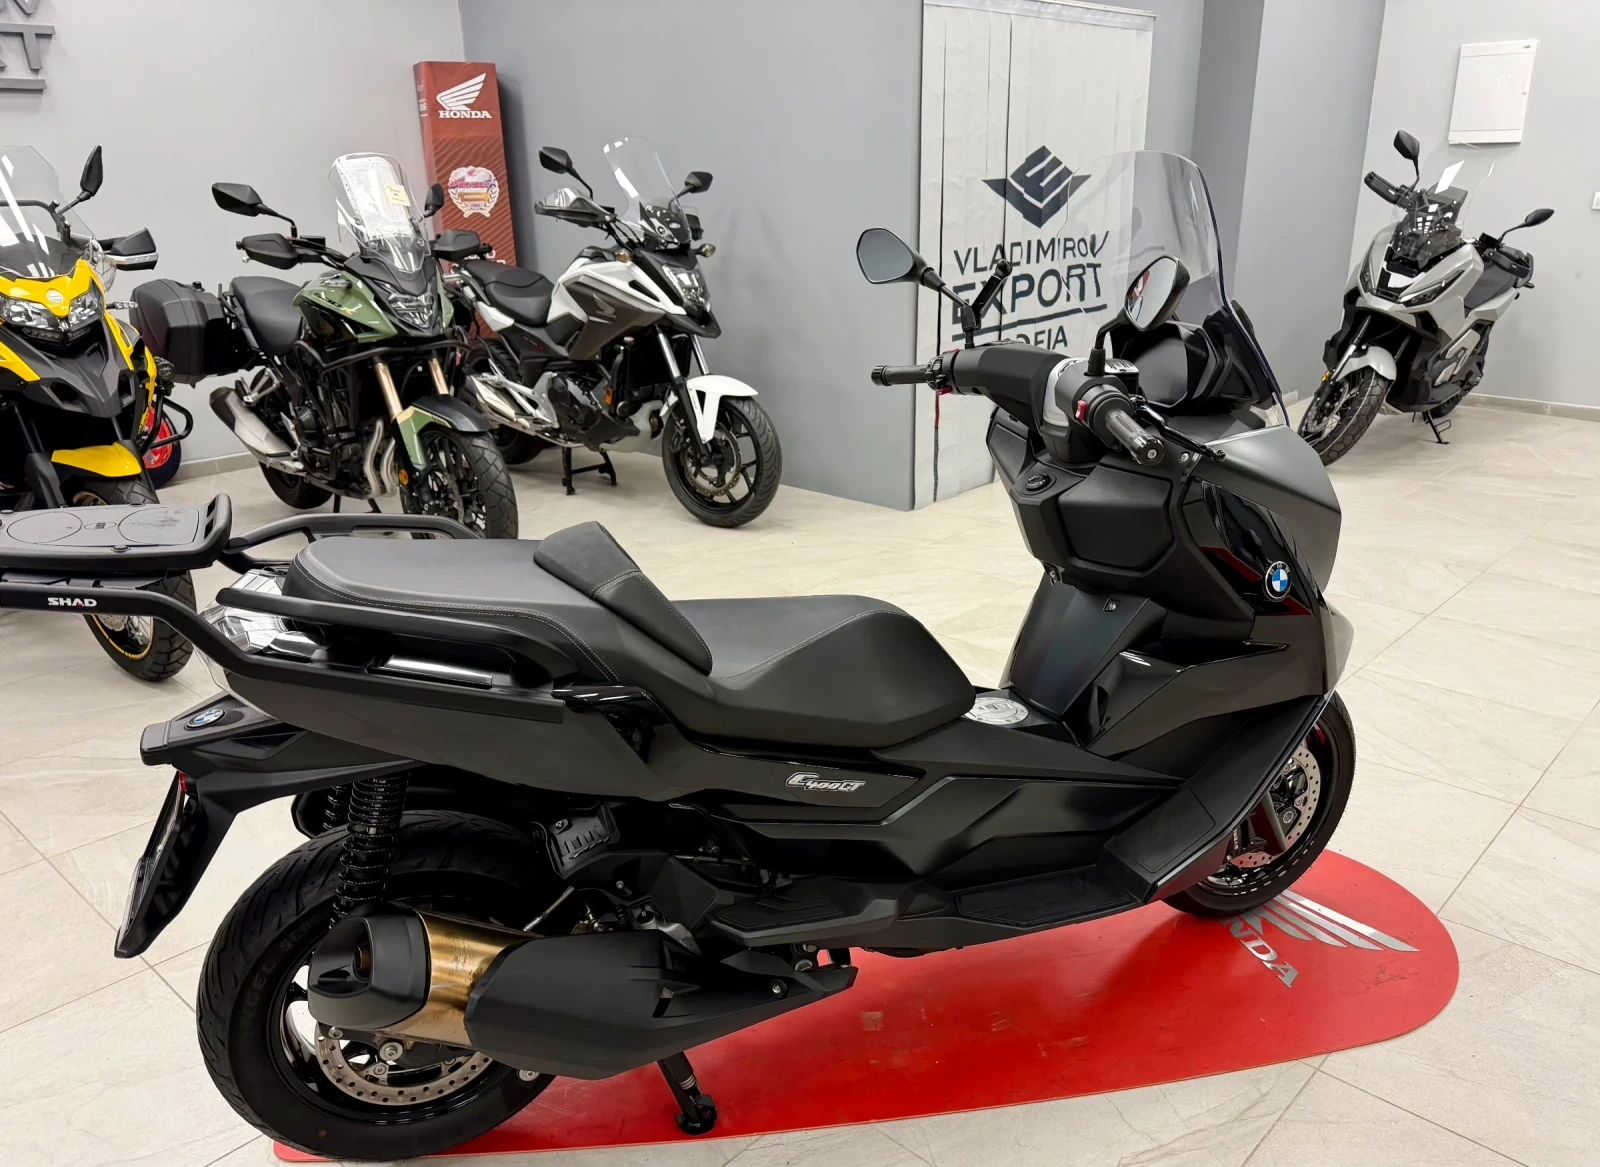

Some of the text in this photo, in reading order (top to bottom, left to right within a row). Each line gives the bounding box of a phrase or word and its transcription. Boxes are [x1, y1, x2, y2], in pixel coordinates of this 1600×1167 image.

[438, 110, 492, 119] HONDA
[953, 231, 1109, 275] VLADIMIROV
[952, 263, 1101, 325] EXPORT
[48, 597, 97, 607] SHAD
[1224, 915, 1298, 988] NDA
